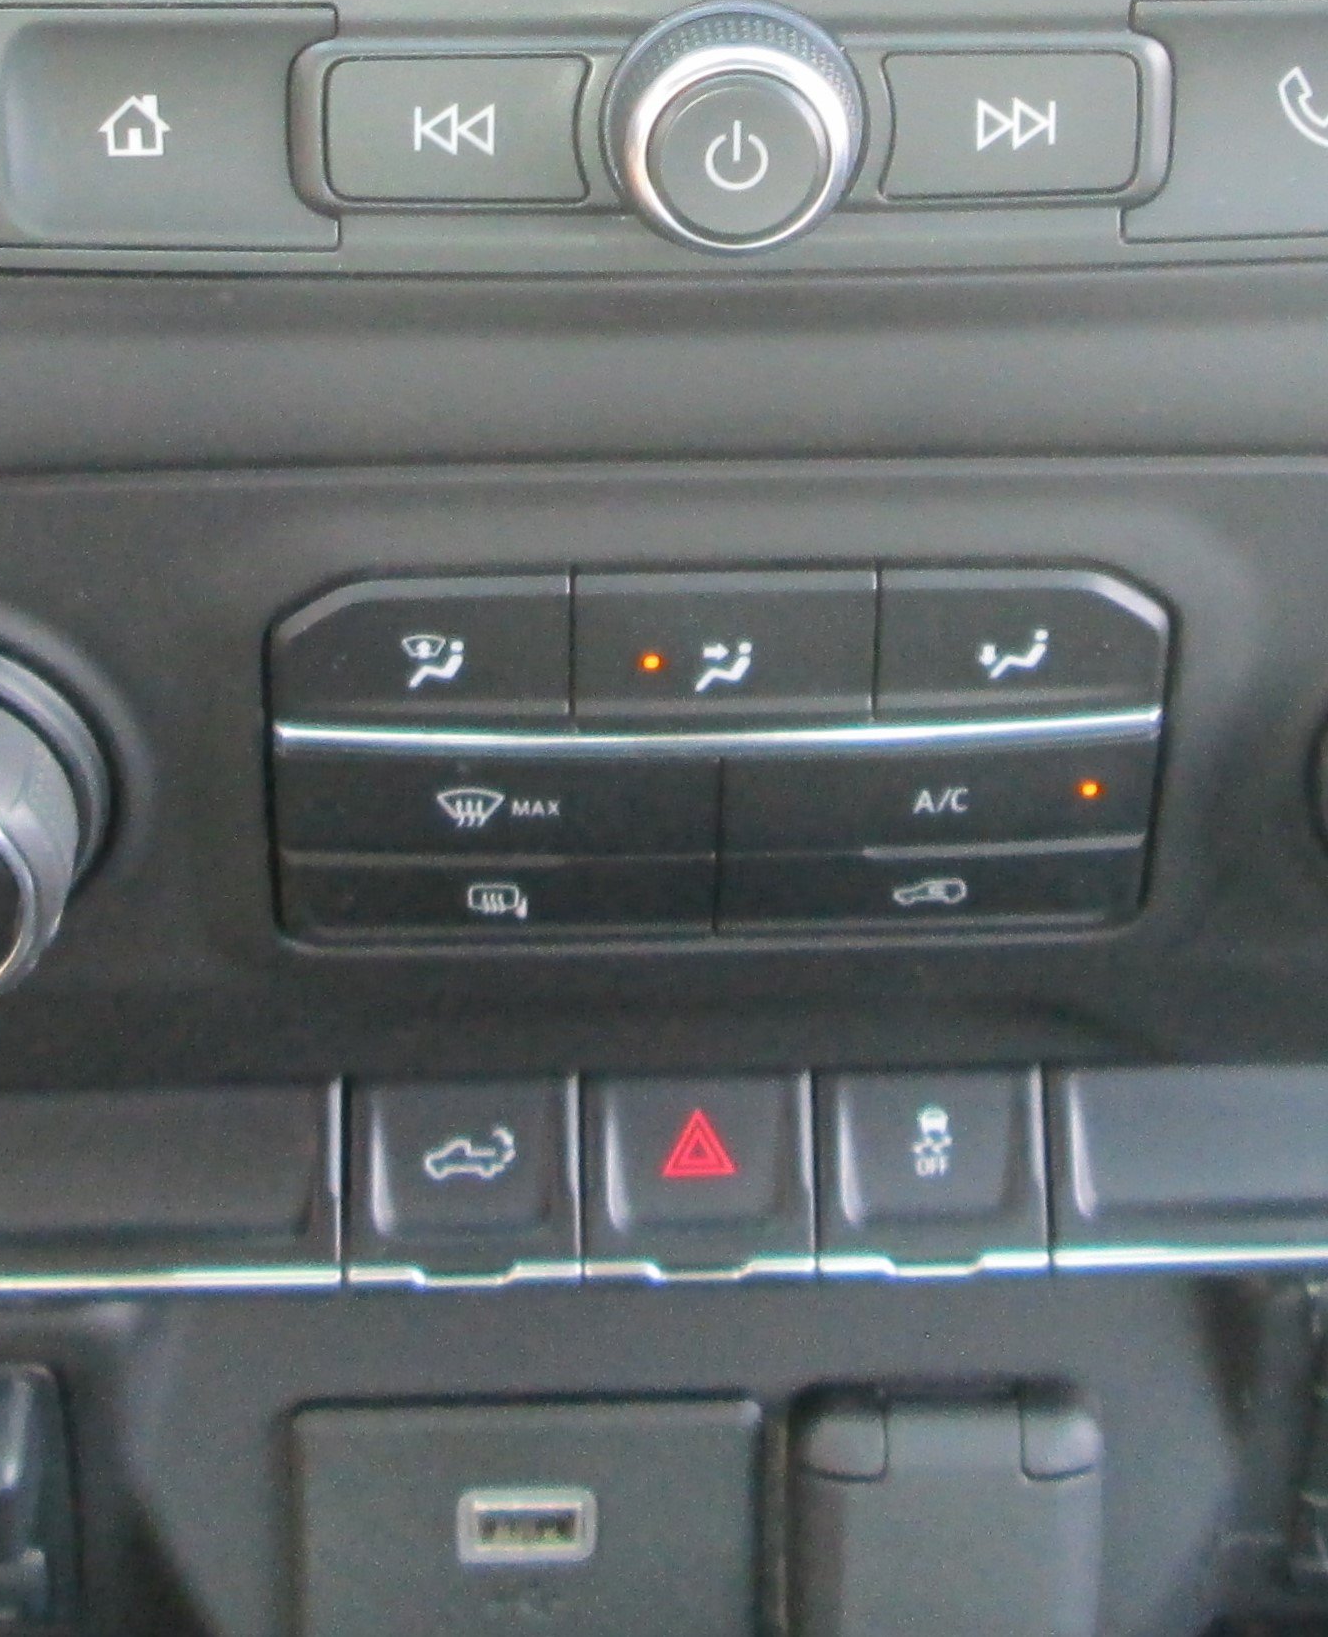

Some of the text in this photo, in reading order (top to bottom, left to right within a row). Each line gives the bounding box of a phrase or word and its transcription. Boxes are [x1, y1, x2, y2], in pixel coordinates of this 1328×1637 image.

[511, 798, 562, 819] MAX
[913, 785, 970, 816] A/C
[915, 1156, 949, 1177] OFF
